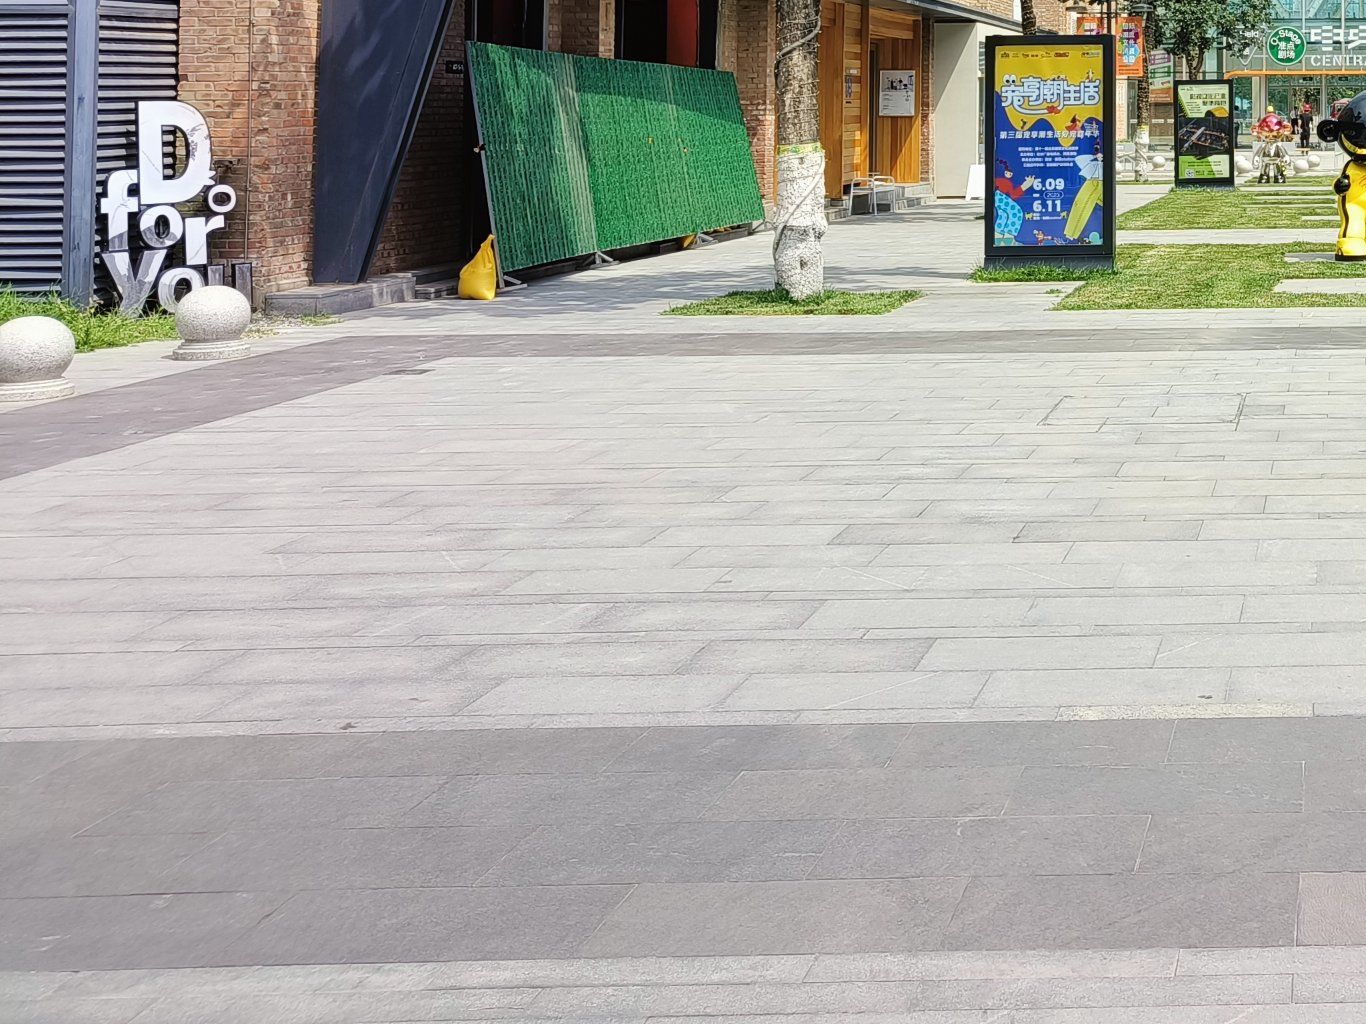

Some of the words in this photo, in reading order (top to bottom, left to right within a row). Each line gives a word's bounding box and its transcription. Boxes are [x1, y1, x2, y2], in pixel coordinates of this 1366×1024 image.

[1270, 29, 1301, 46] O-Stage
[1033, 178, 1065, 191] 6.09
[1033, 199, 1061, 212] 6.11
[101, 169, 225, 265] for
